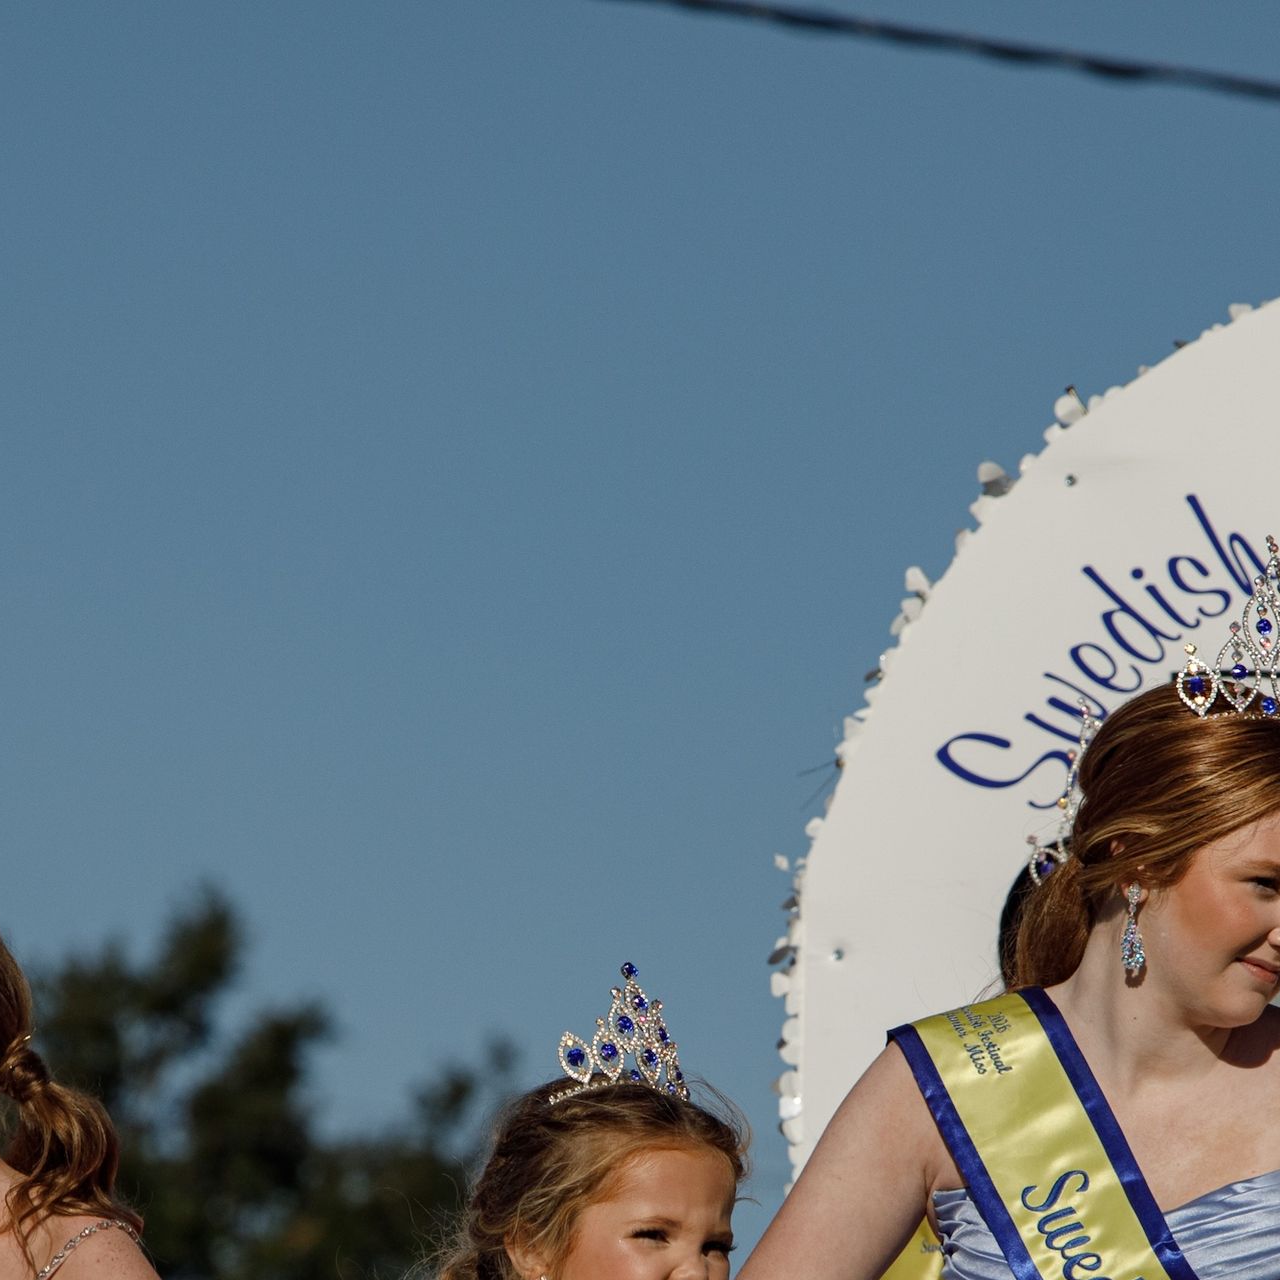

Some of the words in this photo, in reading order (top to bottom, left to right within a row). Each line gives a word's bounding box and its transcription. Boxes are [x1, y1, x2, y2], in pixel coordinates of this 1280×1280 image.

[935, 493, 1277, 810] Swedish
[963, 1043, 988, 1075] Miss
[977, 1029, 1013, 1075] Festival
